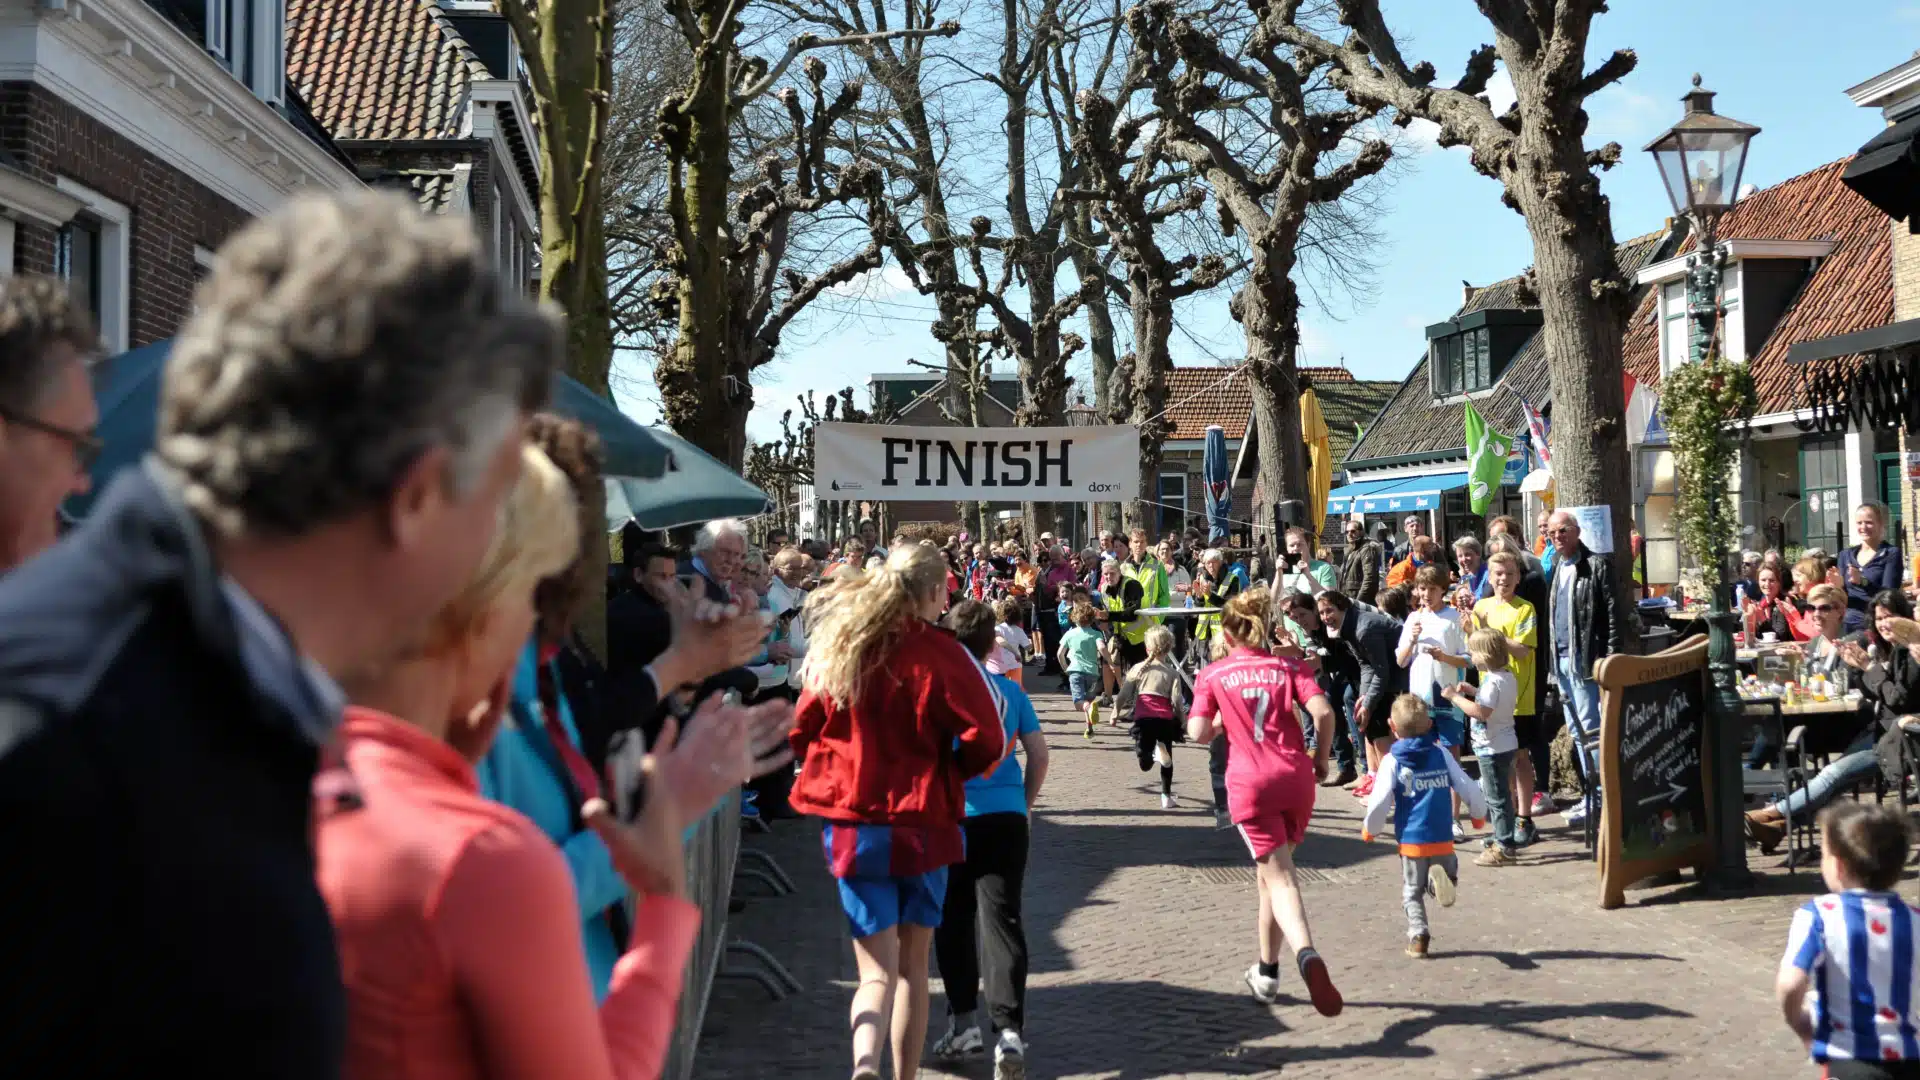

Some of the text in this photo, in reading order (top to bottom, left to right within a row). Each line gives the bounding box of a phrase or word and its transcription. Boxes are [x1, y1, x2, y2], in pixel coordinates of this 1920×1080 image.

[881, 437, 1073, 487] FINISH
[1220, 668, 1285, 690] RONALDO
[1241, 687, 1270, 743] 7
[1415, 774, 1449, 792] Brasil
